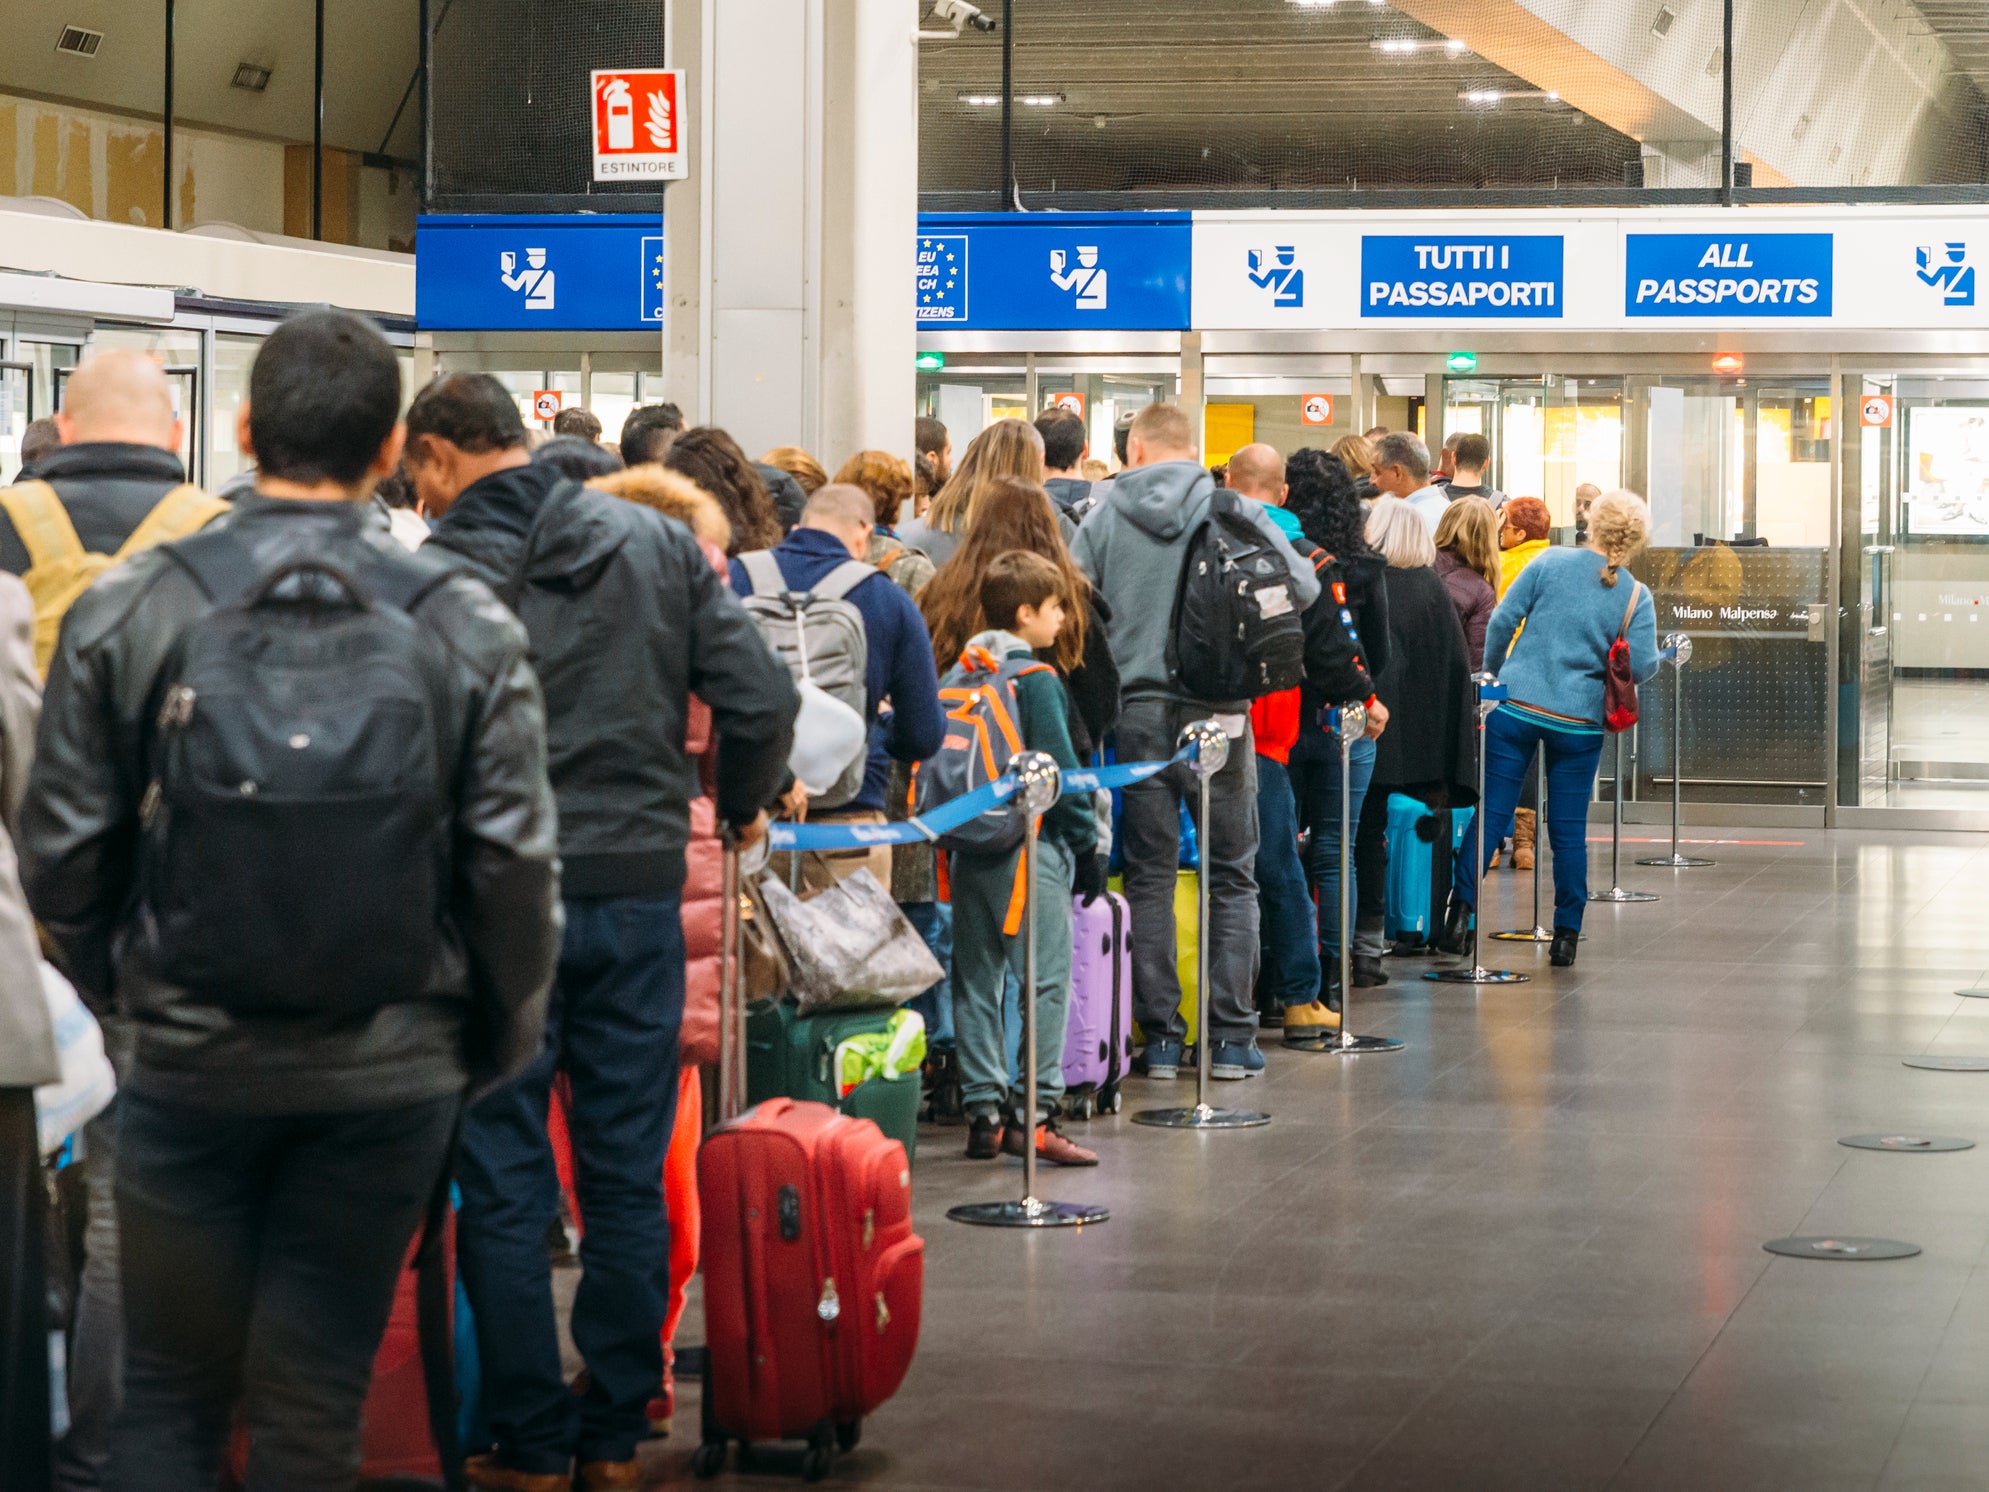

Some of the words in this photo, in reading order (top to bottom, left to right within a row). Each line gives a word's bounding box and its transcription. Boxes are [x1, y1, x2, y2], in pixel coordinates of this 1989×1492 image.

[601, 162, 676, 174] ESTINTORE
[918, 252, 937, 263] EU
[1414, 245, 1494, 270] TUTTI
[1501, 245, 1509, 270] I
[1697, 243, 1754, 268] ALL
[917, 265, 939, 276] EEA
[918, 278, 938, 290] CH
[1635, 278, 1819, 304] PASSPORTS
[1369, 281, 1555, 307] PASSAPORTI
[915, 306, 955, 318] TIZENS
[1673, 606, 1713, 620] Milano
[1720, 606, 1777, 622] Malpensa
